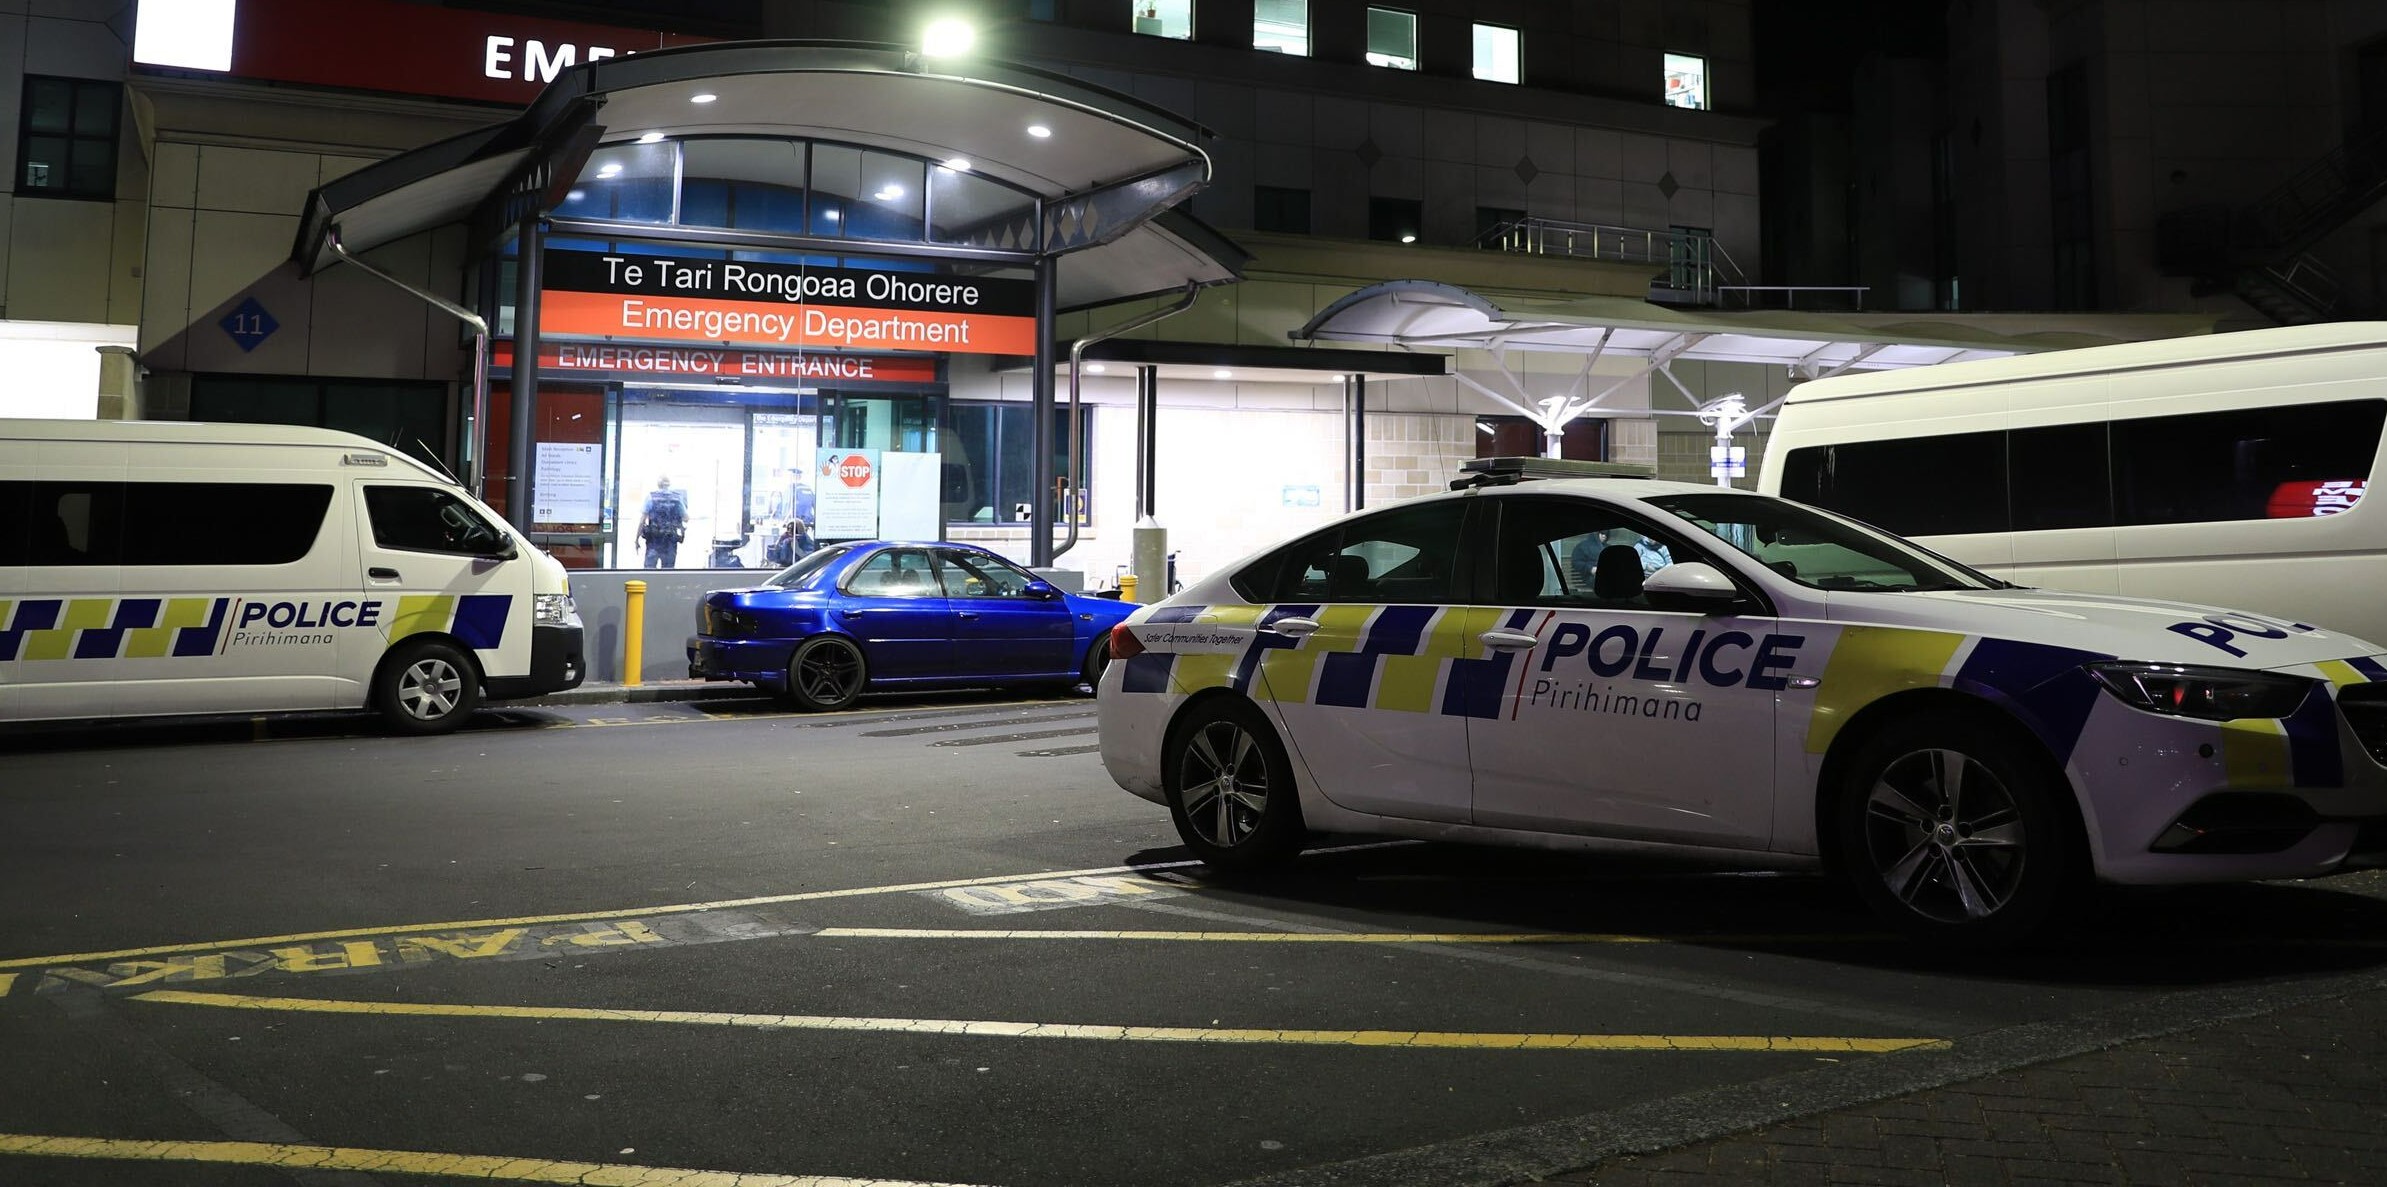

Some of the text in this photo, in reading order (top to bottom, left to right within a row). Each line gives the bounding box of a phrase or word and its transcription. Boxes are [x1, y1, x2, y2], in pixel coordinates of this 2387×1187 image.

[484, 35, 636, 84] EM
[603, 257, 980, 306] Te Tari Rongoaa Ohorere
[233, 313, 264, 335] 11
[622, 300, 970, 346] Emergency Department
[558, 345, 874, 379] EMERGENCY ENTRANCE
[840, 465, 870, 479] STOP
[239, 602, 383, 629] POLICE
[232, 631, 334, 646] Pirihimana
[1144, 632, 1244, 646] Safer Communities Together
[1540, 622, 1806, 691] POLICE
[1530, 680, 1702, 722] Pirihimana
